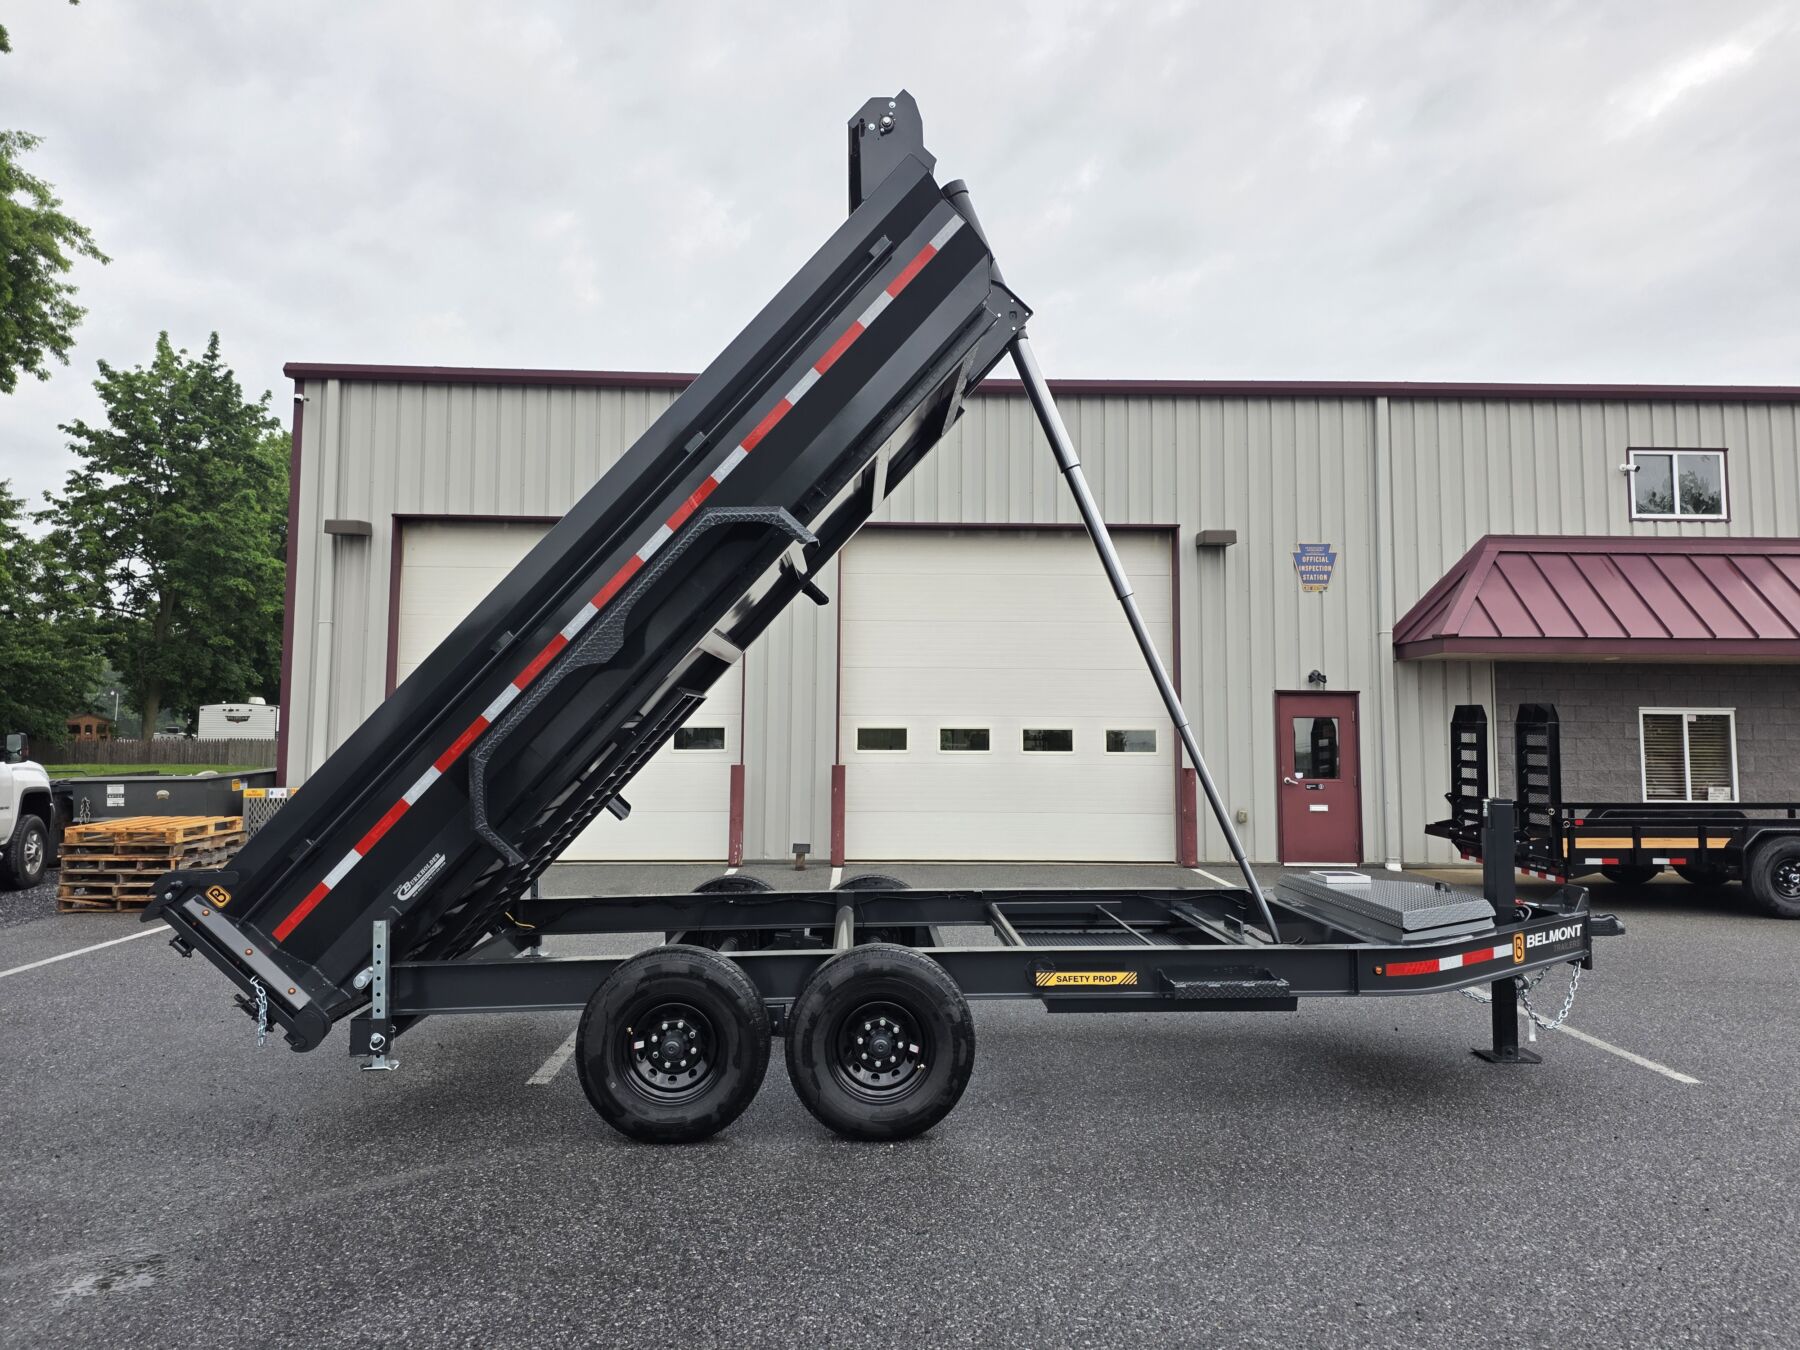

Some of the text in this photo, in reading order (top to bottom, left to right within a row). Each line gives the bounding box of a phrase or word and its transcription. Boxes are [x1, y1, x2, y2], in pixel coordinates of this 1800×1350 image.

[1526, 924, 1583, 949] BELMONT
[1056, 975, 1118, 983] SAFETY PROP
